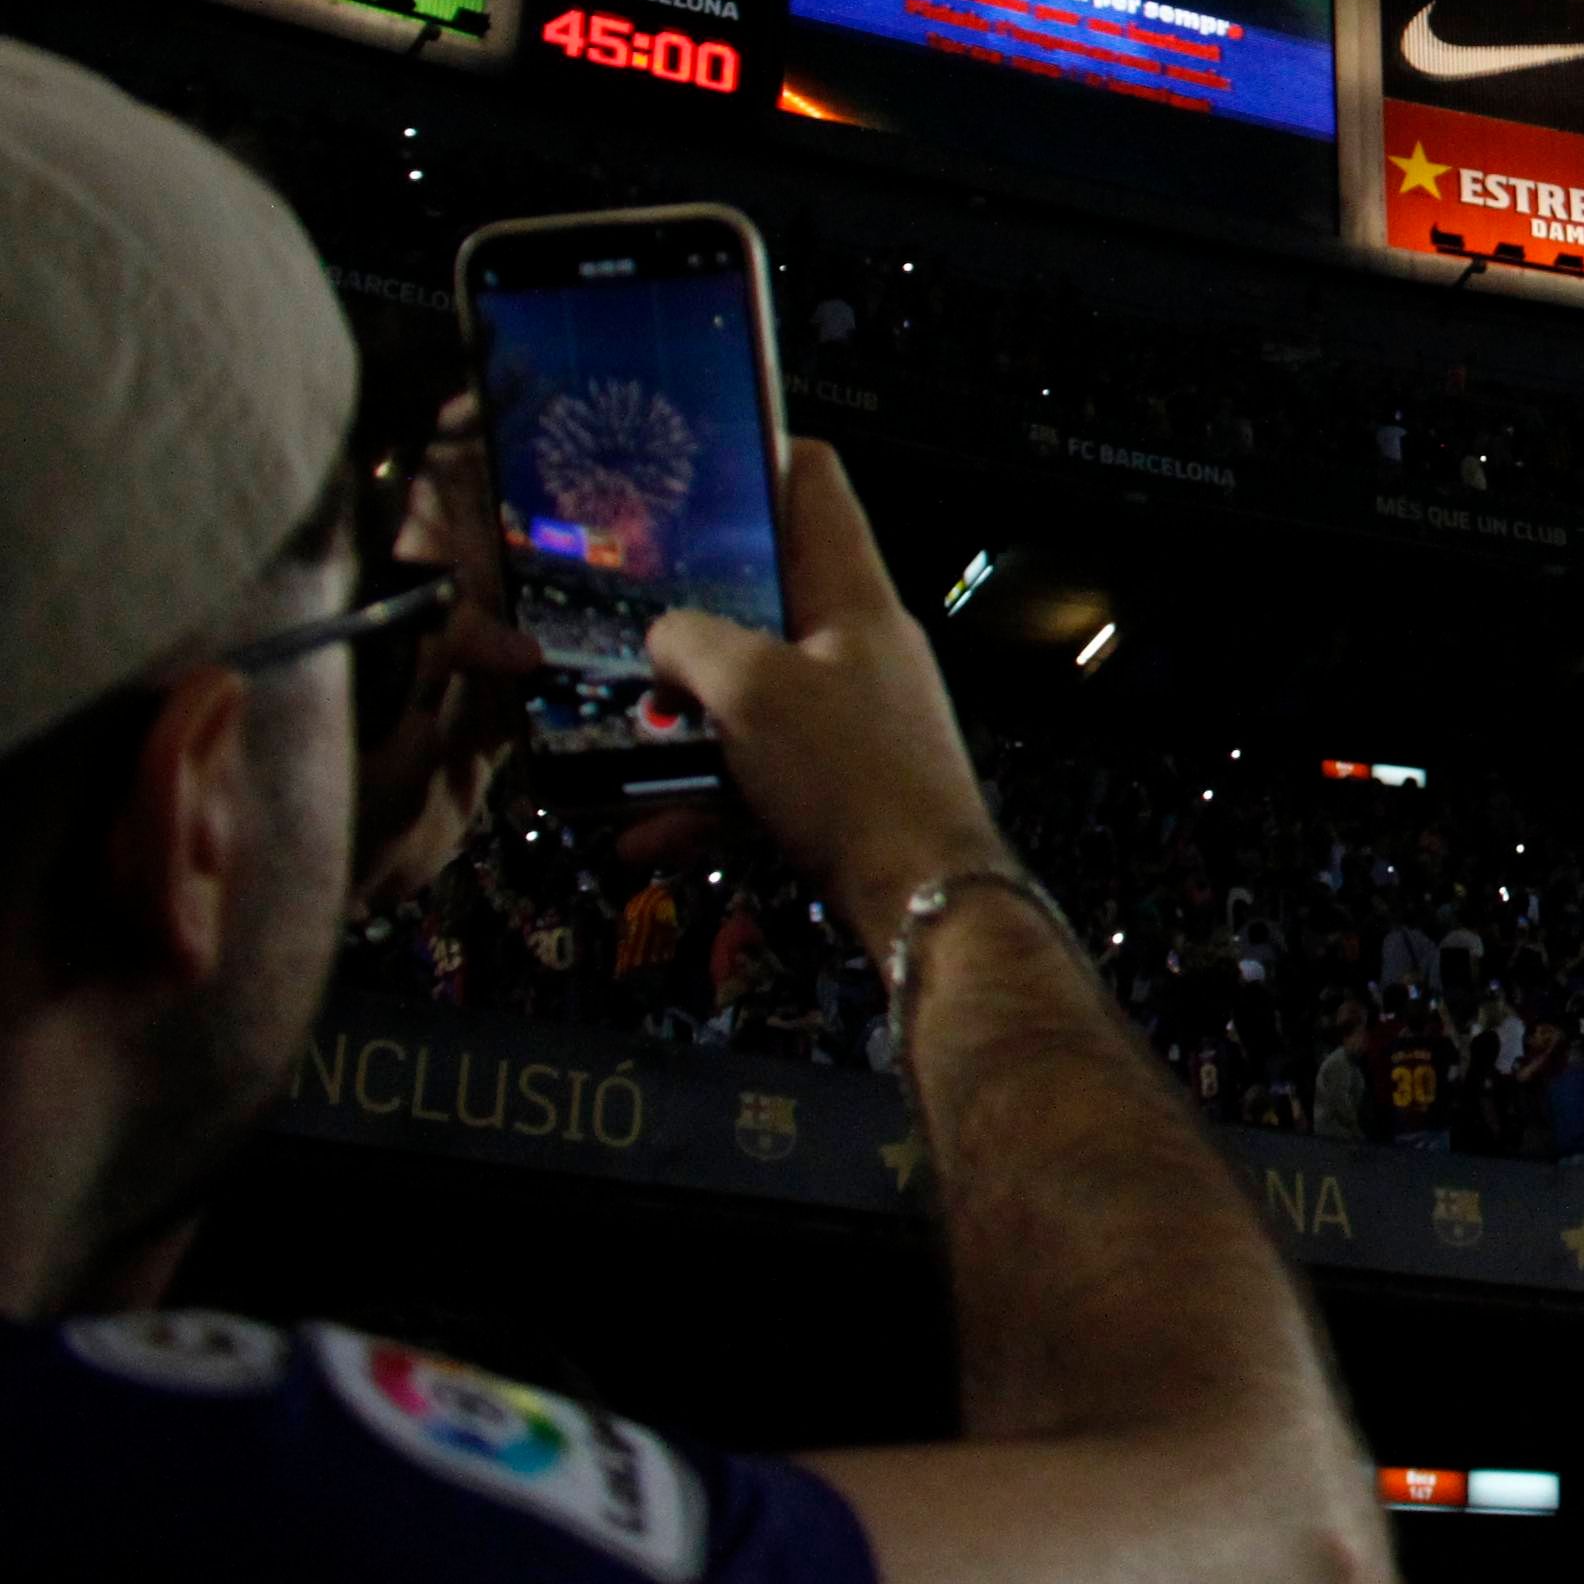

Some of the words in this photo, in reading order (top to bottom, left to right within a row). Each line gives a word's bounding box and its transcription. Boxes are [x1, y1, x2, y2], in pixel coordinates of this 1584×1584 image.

[543, 10, 741, 93] 45:00
[1067, 436, 1096, 461] FC
[1099, 441, 1237, 489] BARCELONA
[1427, 505, 1471, 530] QUE
[1512, 520, 1568, 547] CLUB
[290, 1031, 646, 1150] NCLUSIÓ
[1391, 1064, 1438, 1108] 30
